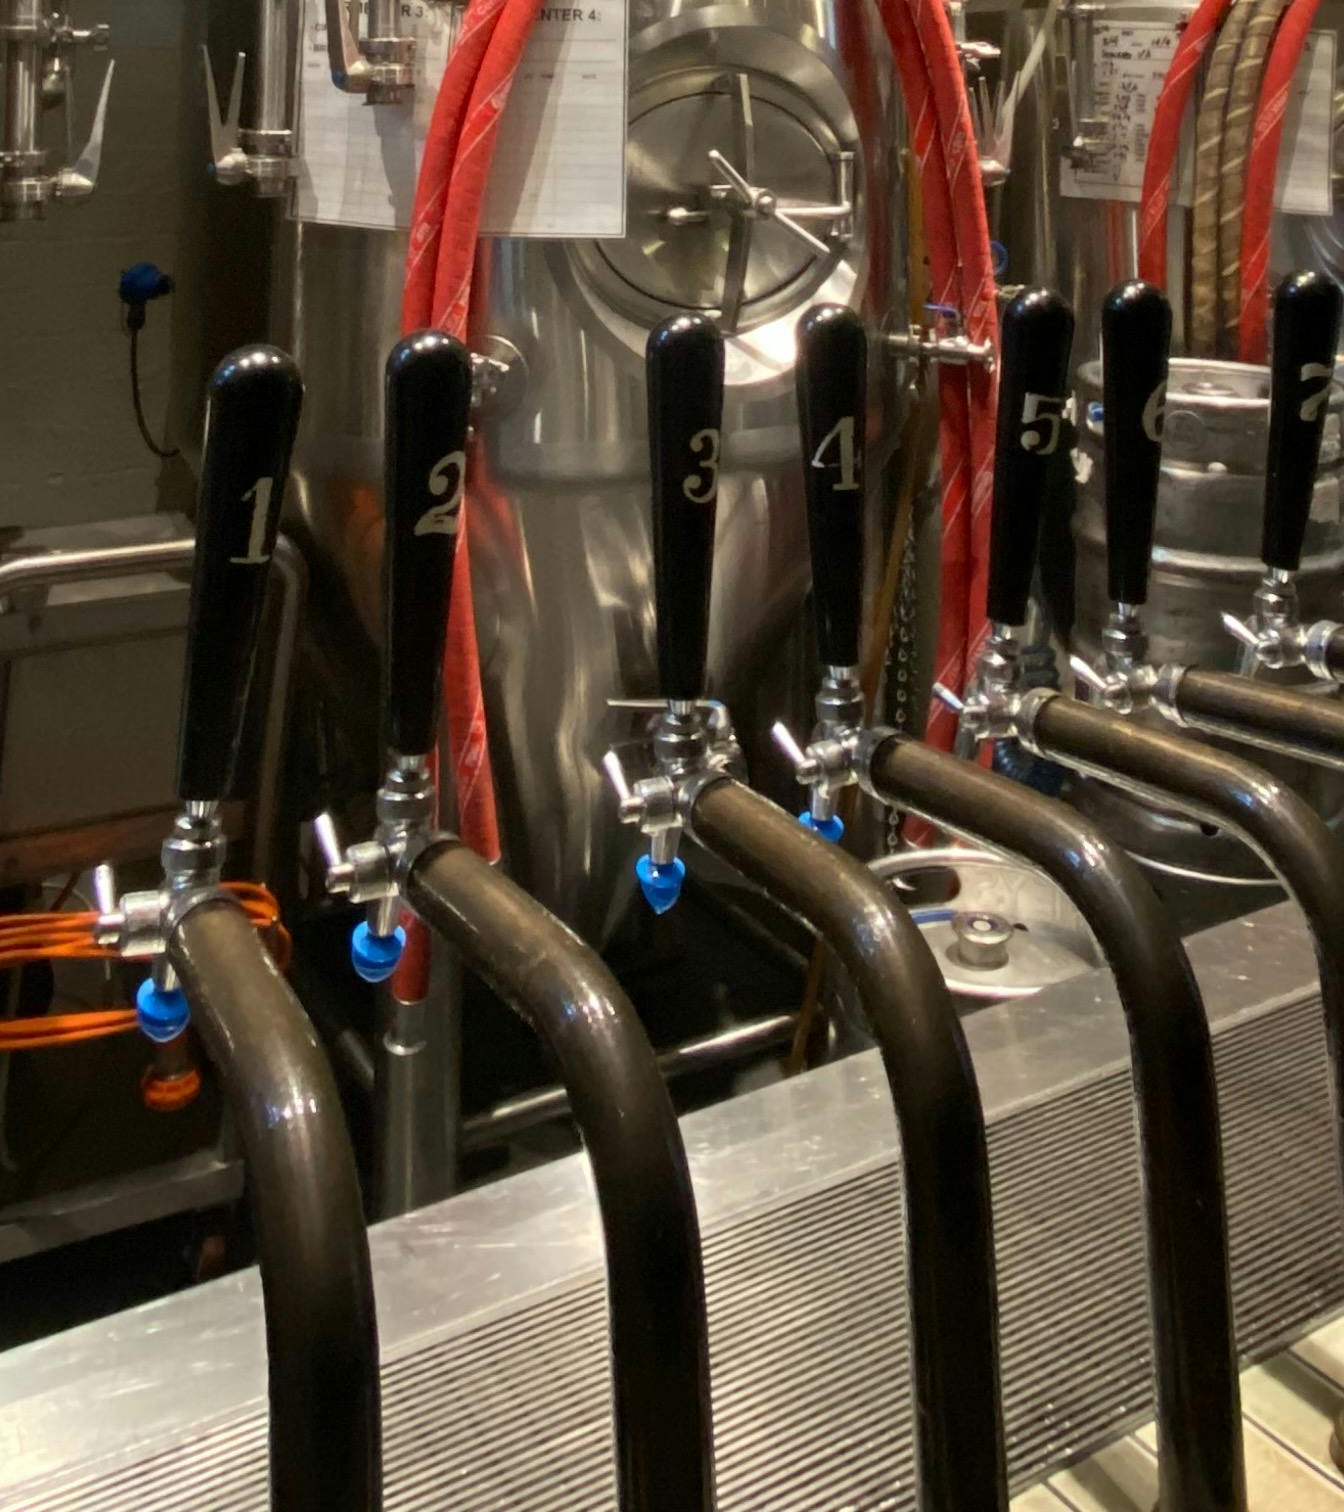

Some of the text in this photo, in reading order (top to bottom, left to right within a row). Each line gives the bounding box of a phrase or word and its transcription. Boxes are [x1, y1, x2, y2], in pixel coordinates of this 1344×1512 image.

[1019, 393, 1064, 455] 5
[1300, 362, 1334, 421] 7
[682, 428, 720, 504] 3
[811, 416, 859, 491] 4
[229, 476, 274, 564] 1
[413, 450, 466, 537] 2
